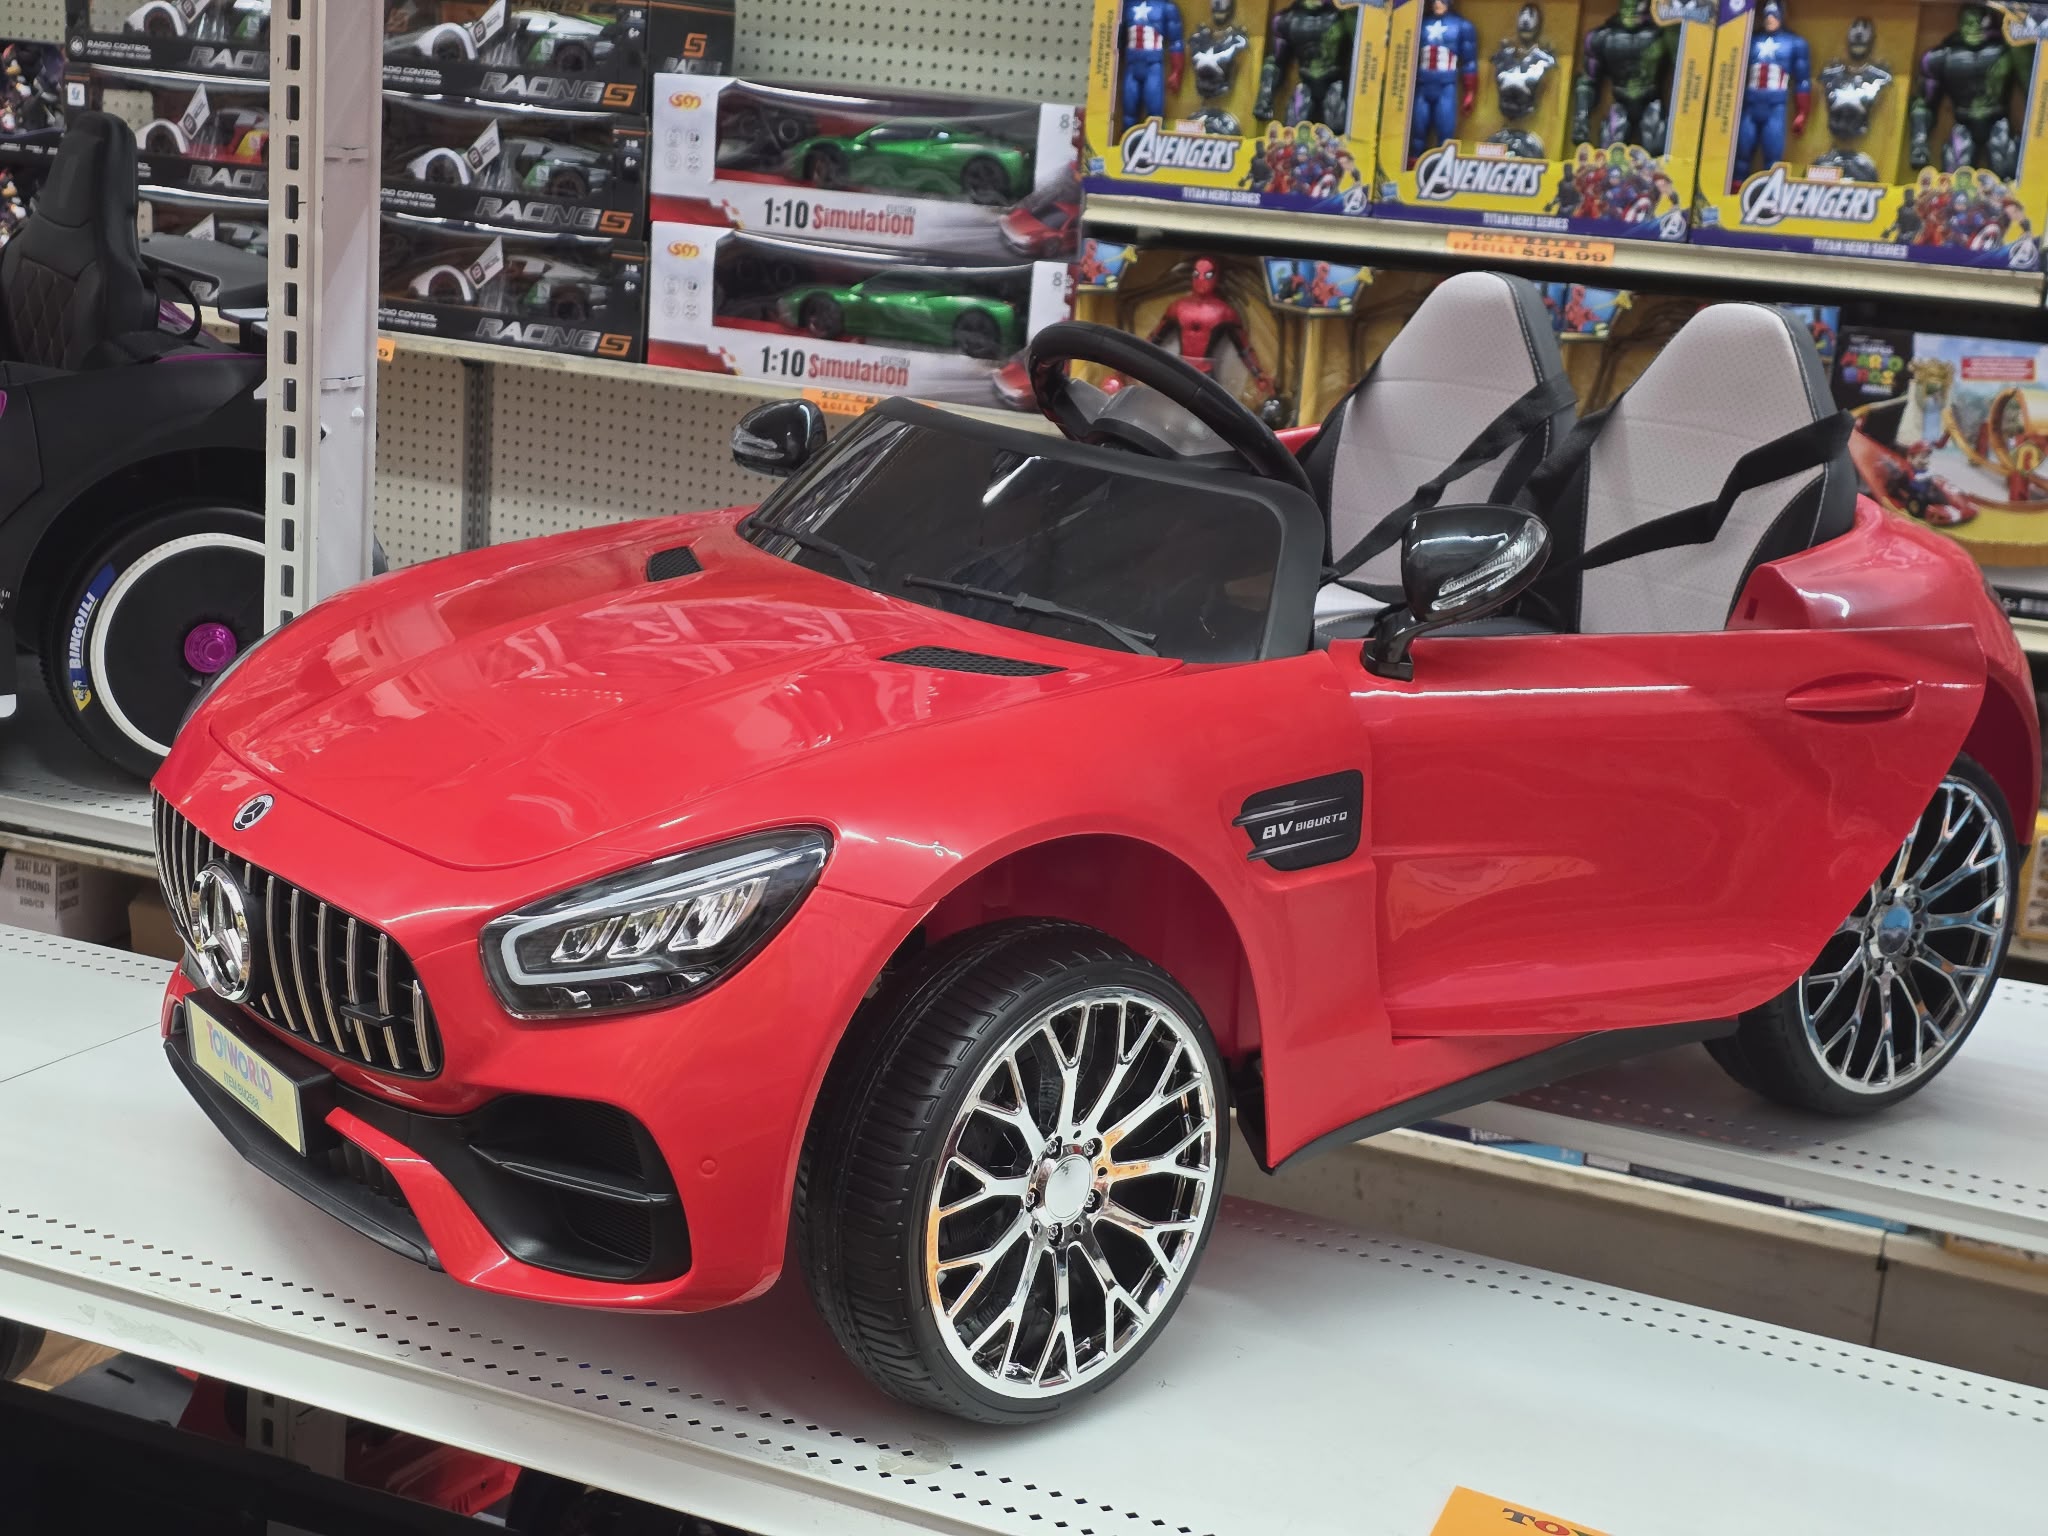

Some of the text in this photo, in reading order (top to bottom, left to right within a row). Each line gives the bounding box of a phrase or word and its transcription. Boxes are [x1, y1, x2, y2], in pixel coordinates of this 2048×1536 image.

[113, 42, 151, 52] CONTROL
[383, 65, 402, 75] ADIO
[403, 67, 442, 78] CONTROL
[1121, 121, 1242, 175] AVENGERS
[1417, 144, 1548, 201] AVENGERS
[397, 190, 436, 201] CONTROL
[1741, 166, 1885, 225] AVENGERS
[765, 198, 915, 235] 1:10 Simulation
[399, 310, 438, 321] CONTROL
[761, 346, 909, 386] 1:10 Simulation
[16, 877, 50, 895] STRONG
